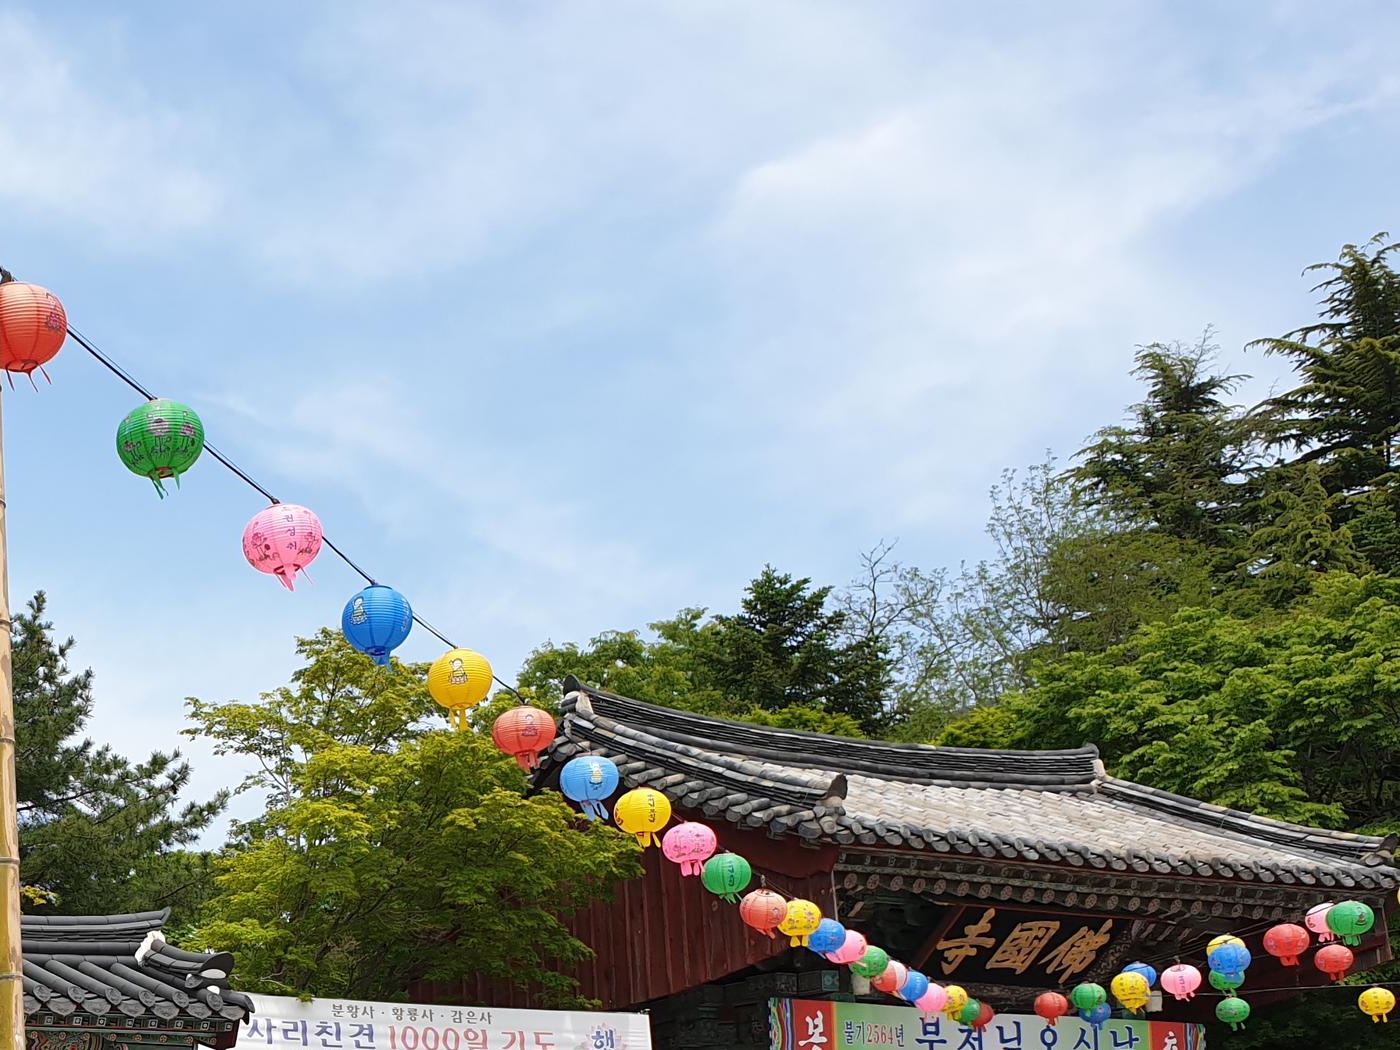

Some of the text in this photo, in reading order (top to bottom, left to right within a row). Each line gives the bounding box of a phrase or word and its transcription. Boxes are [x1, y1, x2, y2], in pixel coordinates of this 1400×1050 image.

[332, 1003, 492, 1025] 분황사 황룡사 감은사
[247, 1016, 376, 1050] 사리친견
[844, 1020, 905, 1048] 불기2564년
